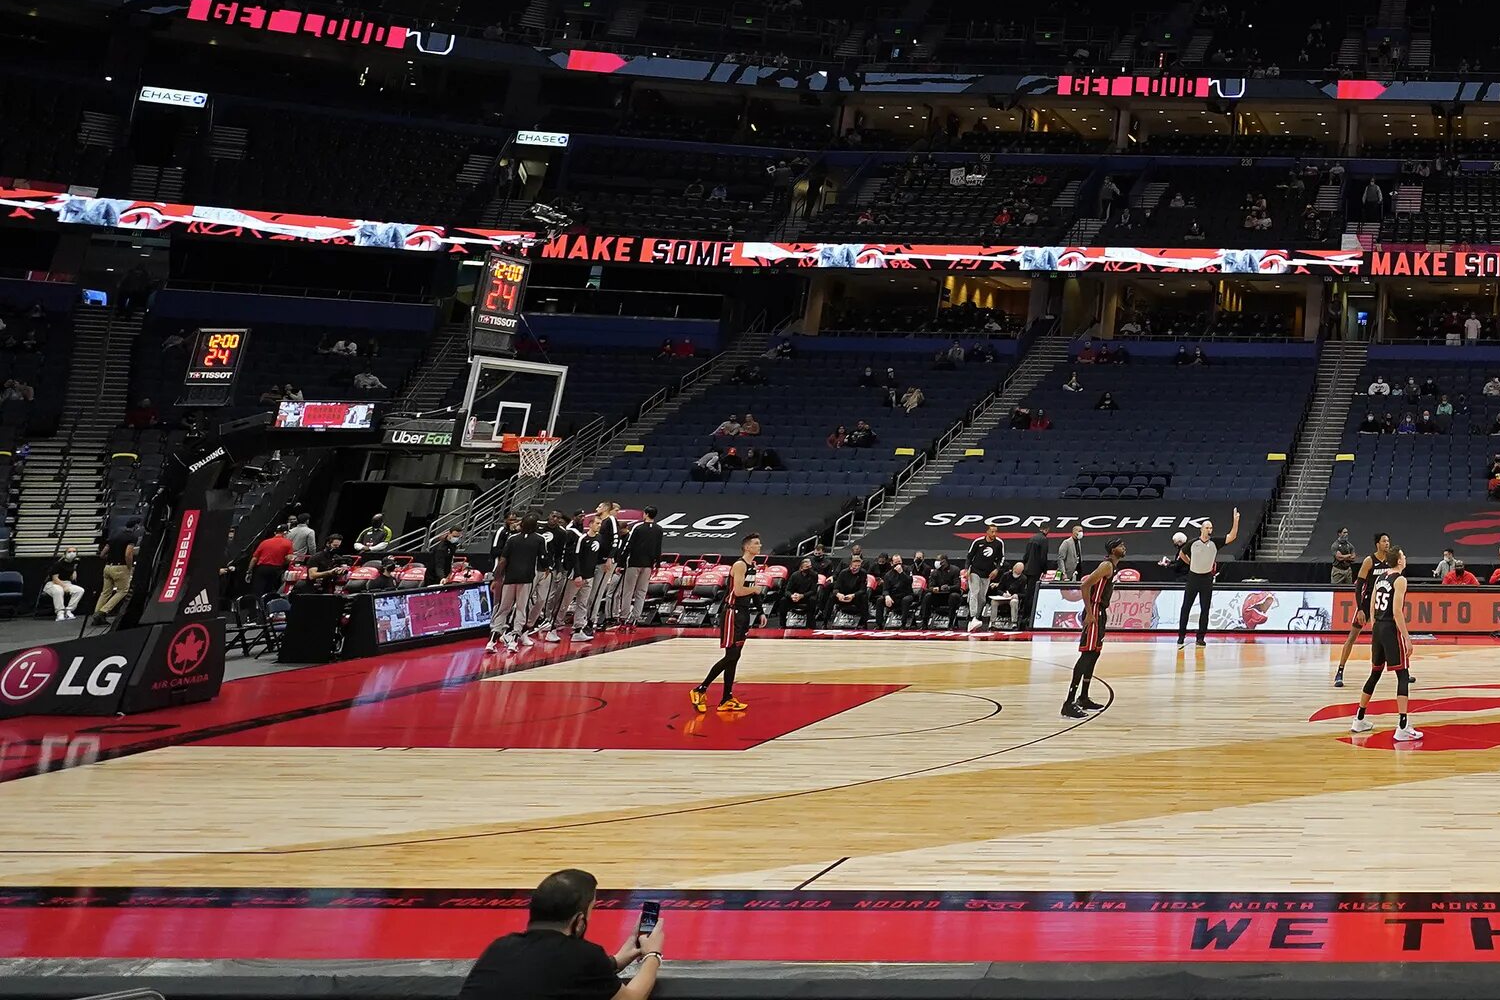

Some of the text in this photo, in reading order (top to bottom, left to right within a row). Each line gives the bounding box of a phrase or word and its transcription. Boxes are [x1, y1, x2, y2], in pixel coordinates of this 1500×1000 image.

[207, 0, 390, 47] GET LOUD
[1071, 75, 1196, 97] GET LOUD
[141, 89, 192, 103] CHASE
[517, 132, 557, 143] CHASE
[1241, 157, 1253, 166] 230
[541, 235, 735, 266] MAKE SOME
[491, 262, 524, 282] 12:00
[1370, 252, 1448, 277] MAKE
[485, 282, 516, 310] 24
[489, 316, 517, 329] TISSOT
[209, 333, 239, 349] 12:00
[204, 349, 230, 366] 24
[201, 371, 233, 379] TISSOT
[391, 430, 424, 444] Uber
[188, 446, 225, 473] SPALDING
[656, 512, 750, 530] LG
[924, 512, 1211, 530] SPORTCHEK
[163, 527, 194, 599] BIOSTEEL
[184, 601, 212, 614] adidas
[1374, 591, 1390, 611] 55
[56, 654, 129, 697] LG
[151, 673, 209, 690] AIR CANADA
[1049, 901, 1127, 910] AREWA
[1228, 901, 1497, 911] NORTH KUZEY NORD
[1189, 917, 1330, 950] WE
